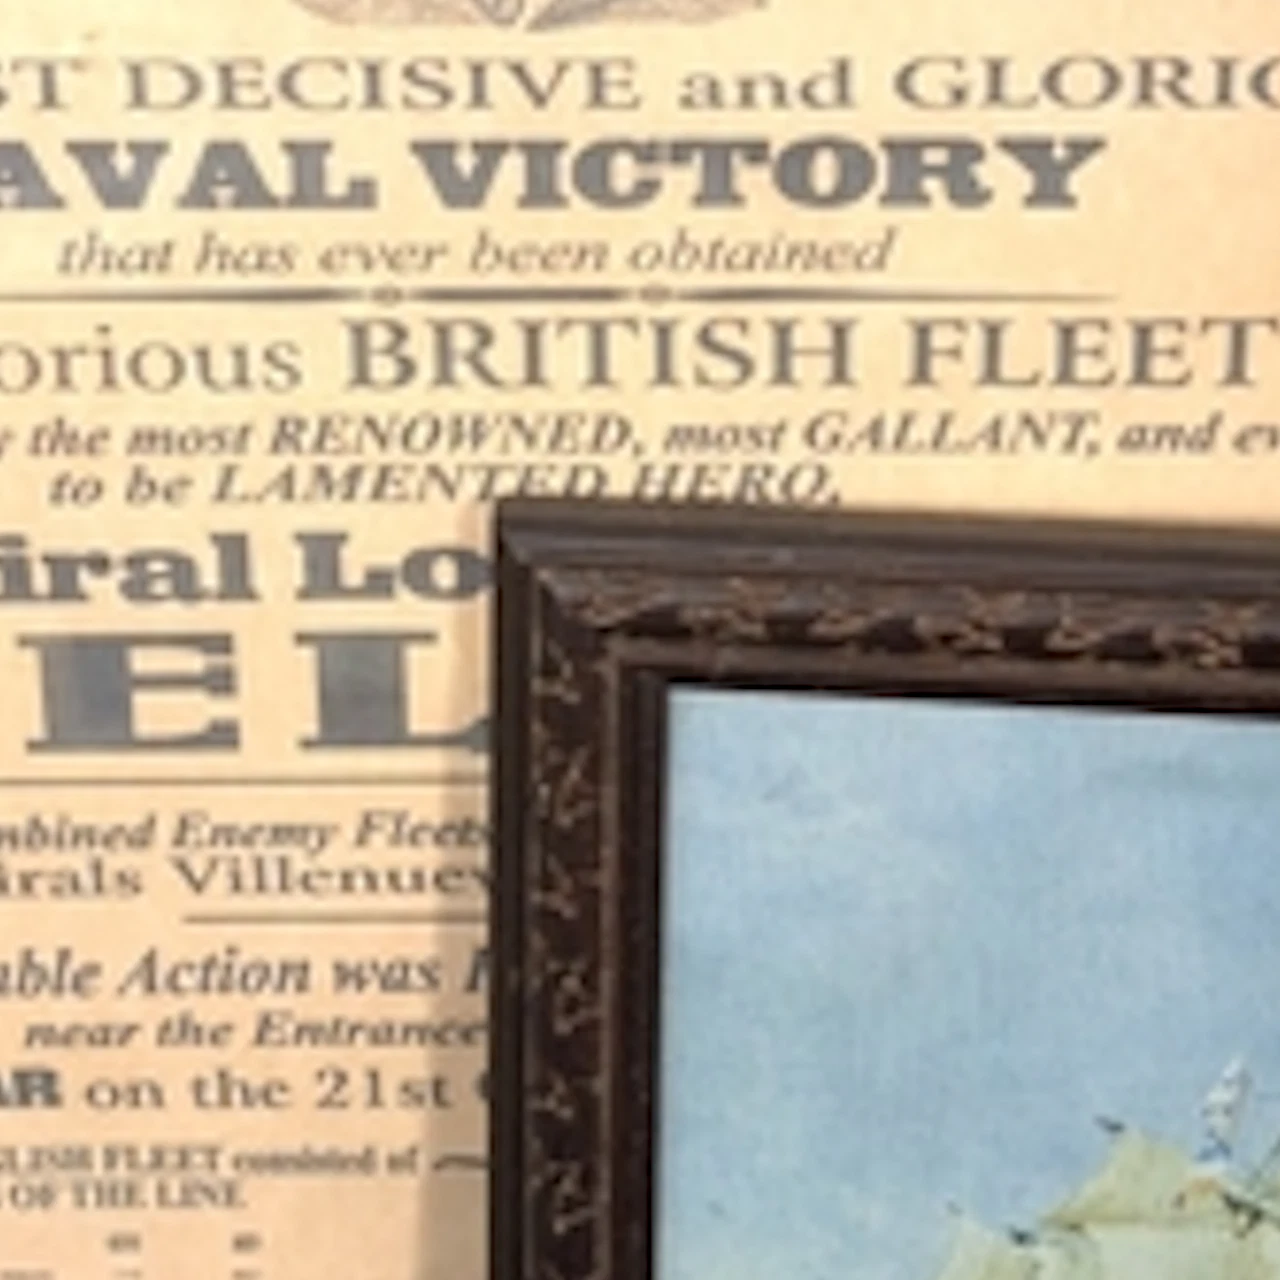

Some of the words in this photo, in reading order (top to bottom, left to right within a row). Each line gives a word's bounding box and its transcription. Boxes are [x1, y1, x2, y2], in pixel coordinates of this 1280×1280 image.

[122, 55, 644, 113] DECISIVE
[677, 55, 858, 111] and
[406, 135, 1108, 211] VICTORY
[58, 229, 176, 277] that
[191, 229, 299, 277] has
[316, 236, 453, 277] ever
[467, 227, 608, 276] been
[624, 226, 900, 275] obtained
[339, 315, 860, 391] BRITISH
[26, 413, 108, 459] the
[124, 418, 255, 459] most
[267, 413, 646, 457] RENOWNED,
[662, 413, 789, 455] most
[801, 412, 1103, 459] GALLANT,
[1115, 412, 1221, 455] and
[46, 466, 107, 508] to
[122, 464, 193, 508] be
[210, 462, 608, 504] LAMENTED
[170, 809, 340, 856] Enemy
[117, 945, 312, 998] Action
[331, 957, 441, 995] was
[24, 1019, 141, 1050] near
[157, 1016, 234, 1049] the
[84, 1077, 168, 1110] on
[189, 1068, 291, 1110] the
[315, 1067, 454, 1110] 21st
[102, 1146, 221, 1173] FLEET
[8, 1183, 57, 1211] OF
[71, 1182, 146, 1210] THE
[157, 1181, 247, 1210] LINE
